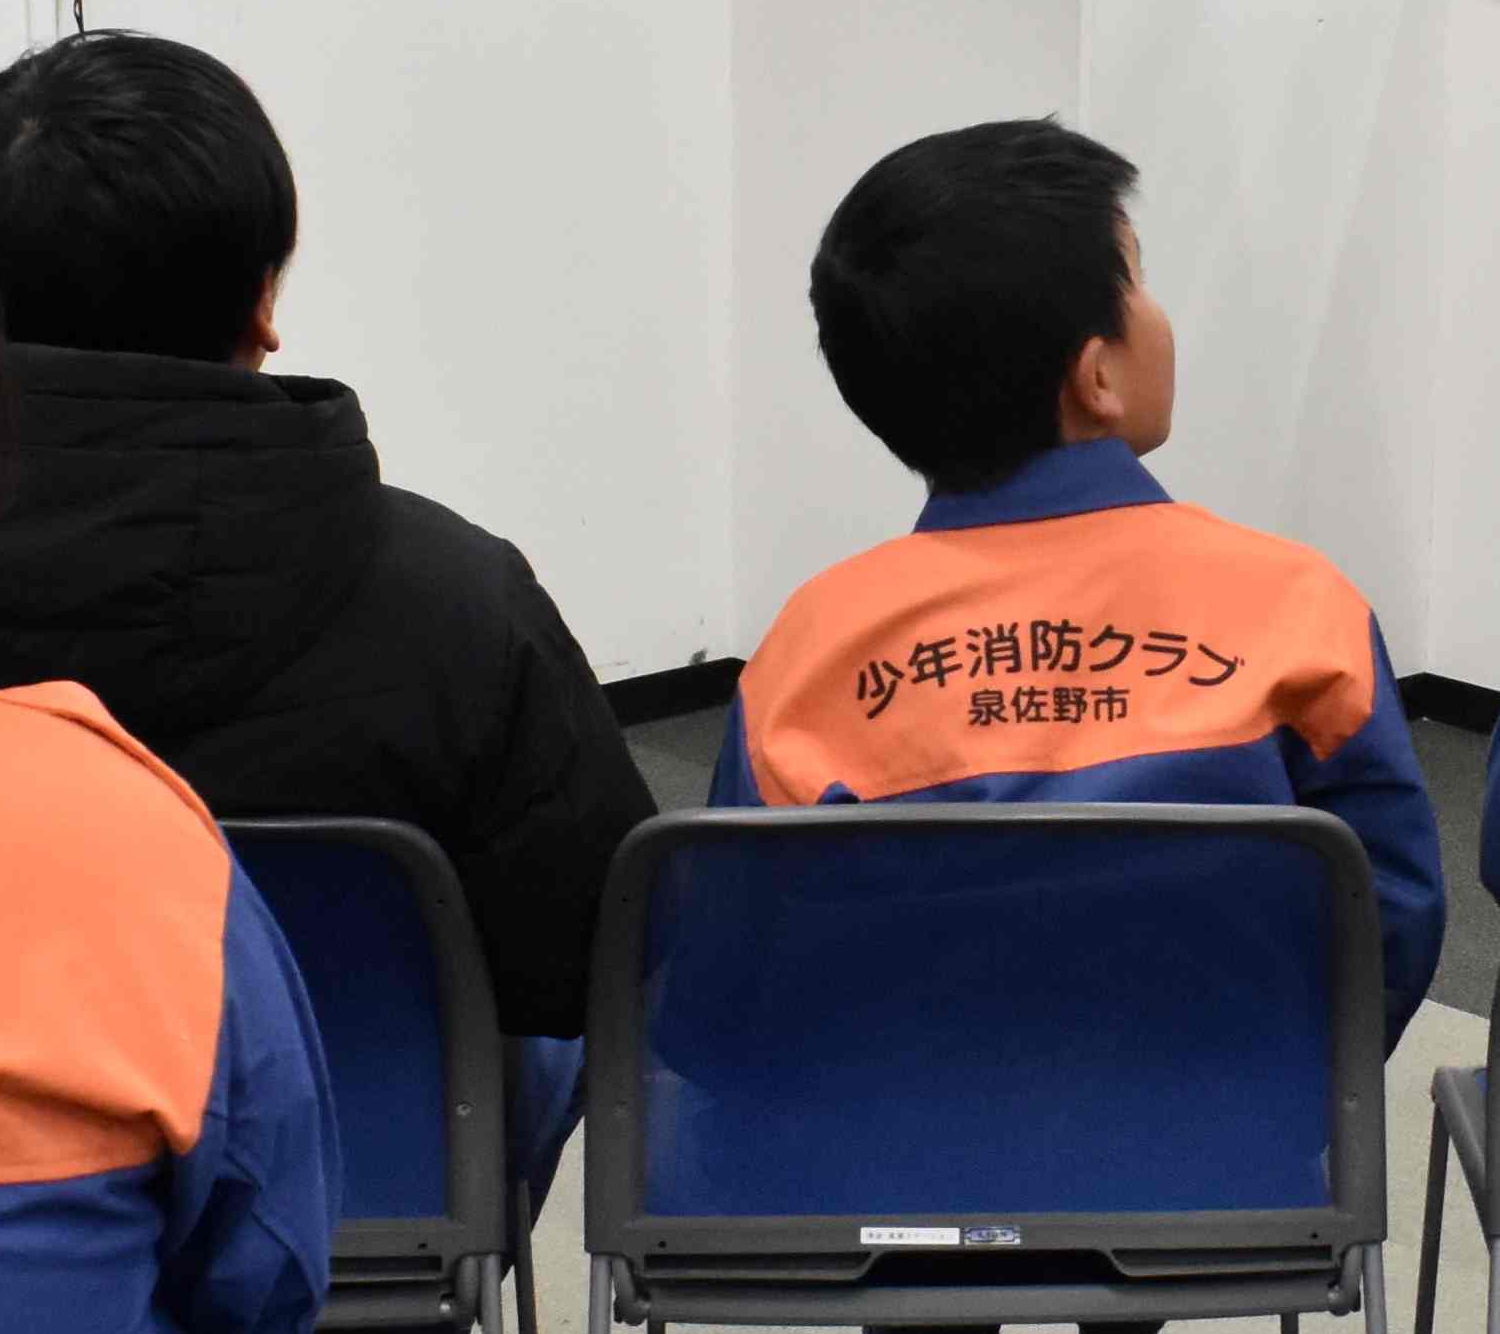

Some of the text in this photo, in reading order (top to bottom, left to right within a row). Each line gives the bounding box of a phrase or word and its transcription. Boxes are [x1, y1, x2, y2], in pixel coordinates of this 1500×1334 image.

[856, 619, 1246, 720] 少年消防クラブ
[967, 686, 1131, 727] 泉佐野市
